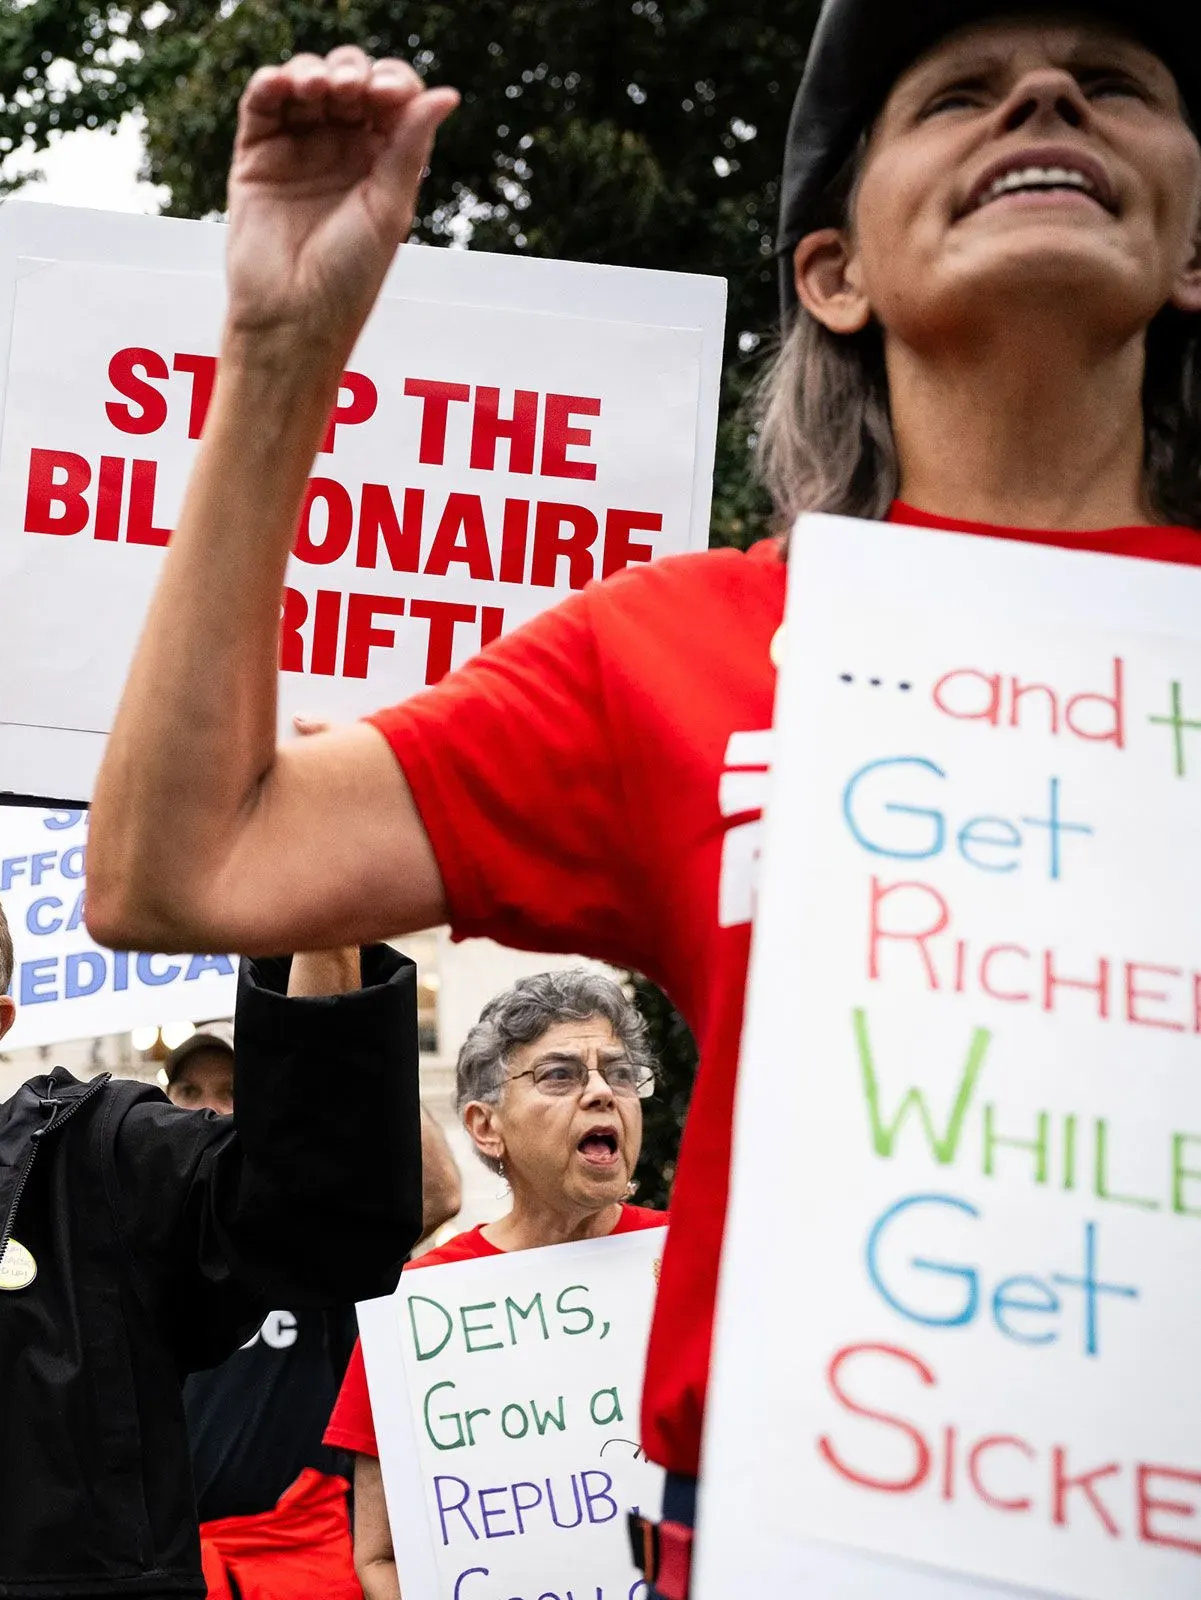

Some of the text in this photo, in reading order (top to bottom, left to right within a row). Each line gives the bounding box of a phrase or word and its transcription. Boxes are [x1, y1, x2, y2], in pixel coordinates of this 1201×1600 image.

[105, 347, 601, 481] STP THE
[24, 448, 663, 591] BILONAIRE
[279, 586, 505, 686] RIFT
[843, 755, 1094, 880] Get
[10, 951, 234, 1006] EDICA
[407, 1285, 611, 1361] DEMS,
[865, 1192, 1139, 1358] Get
[424, 1381, 624, 1451] Grow a
